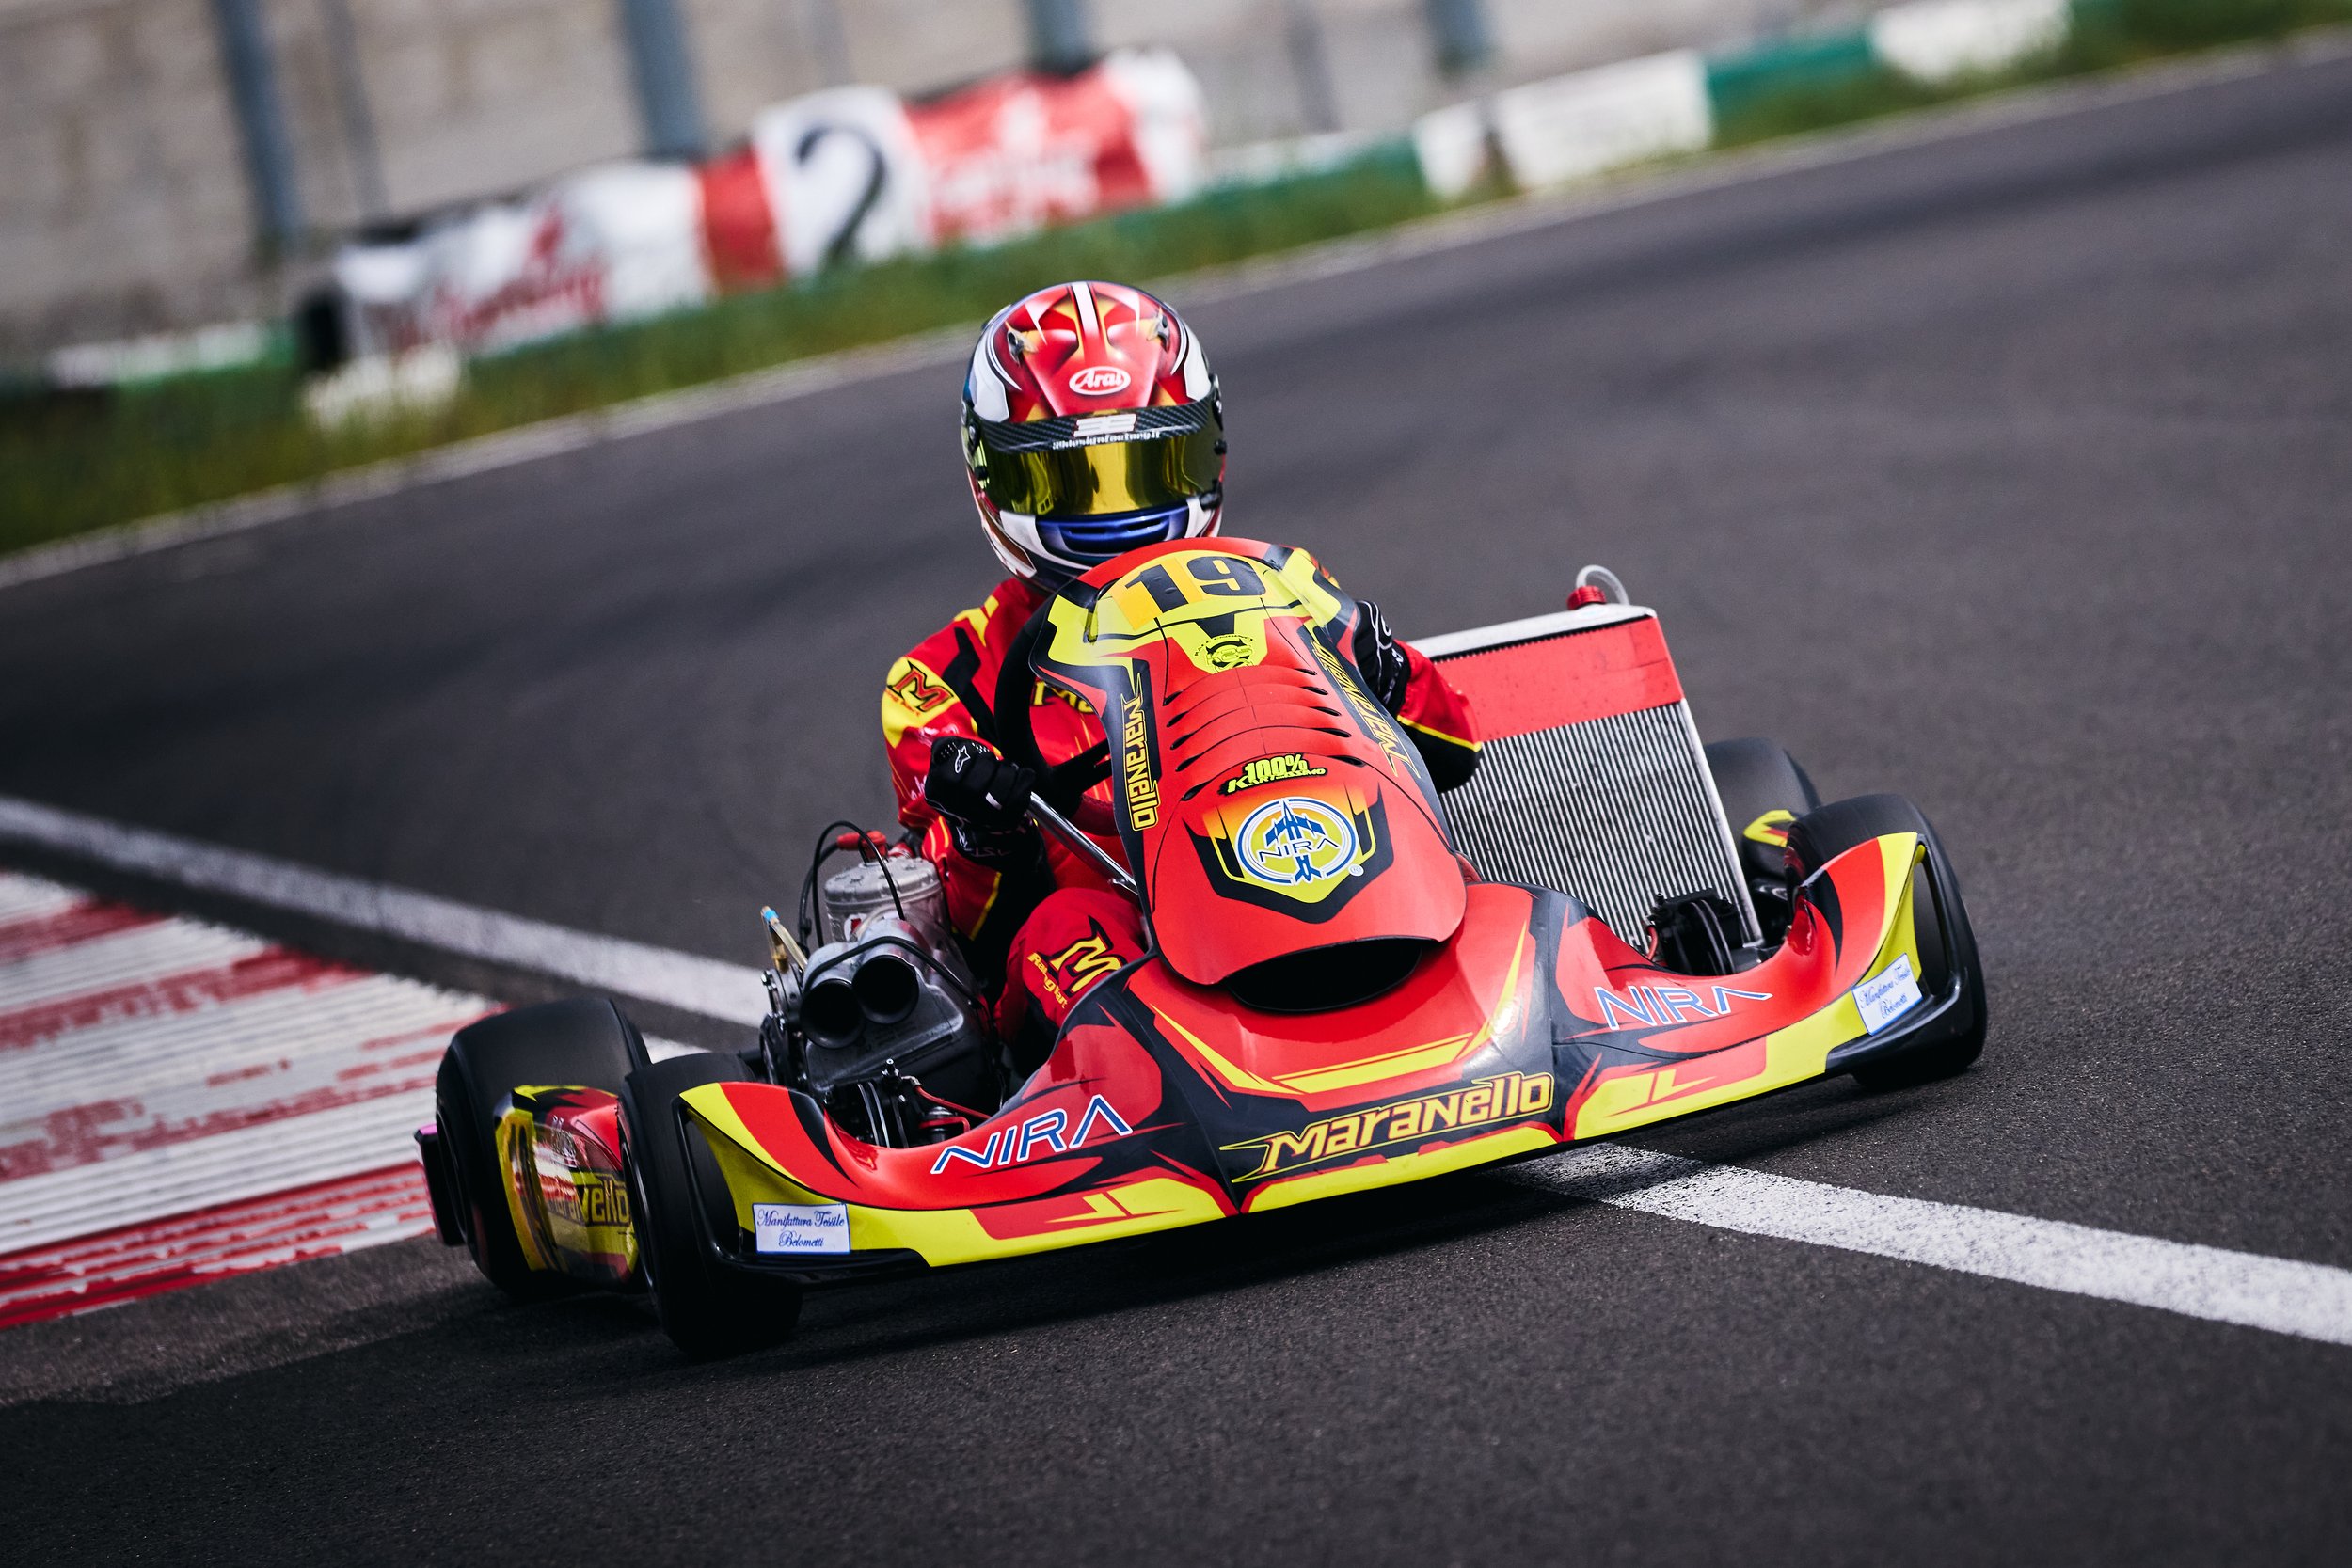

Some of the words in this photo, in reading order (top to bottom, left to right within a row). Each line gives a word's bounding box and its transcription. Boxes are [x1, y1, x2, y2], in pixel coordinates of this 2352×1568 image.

[1074, 368, 1123, 388] Arai
[1124, 555, 1267, 614] 19
[888, 662, 954, 712] M
[1245, 753, 1309, 783] 100%
[1259, 837, 1340, 863] NIRA
[1593, 985, 1773, 1031] NIRA
[930, 1094, 1134, 1174] NIRA
[757, 1209, 812, 1230] Manifattura
[778, 1230, 825, 1247] Belometti
